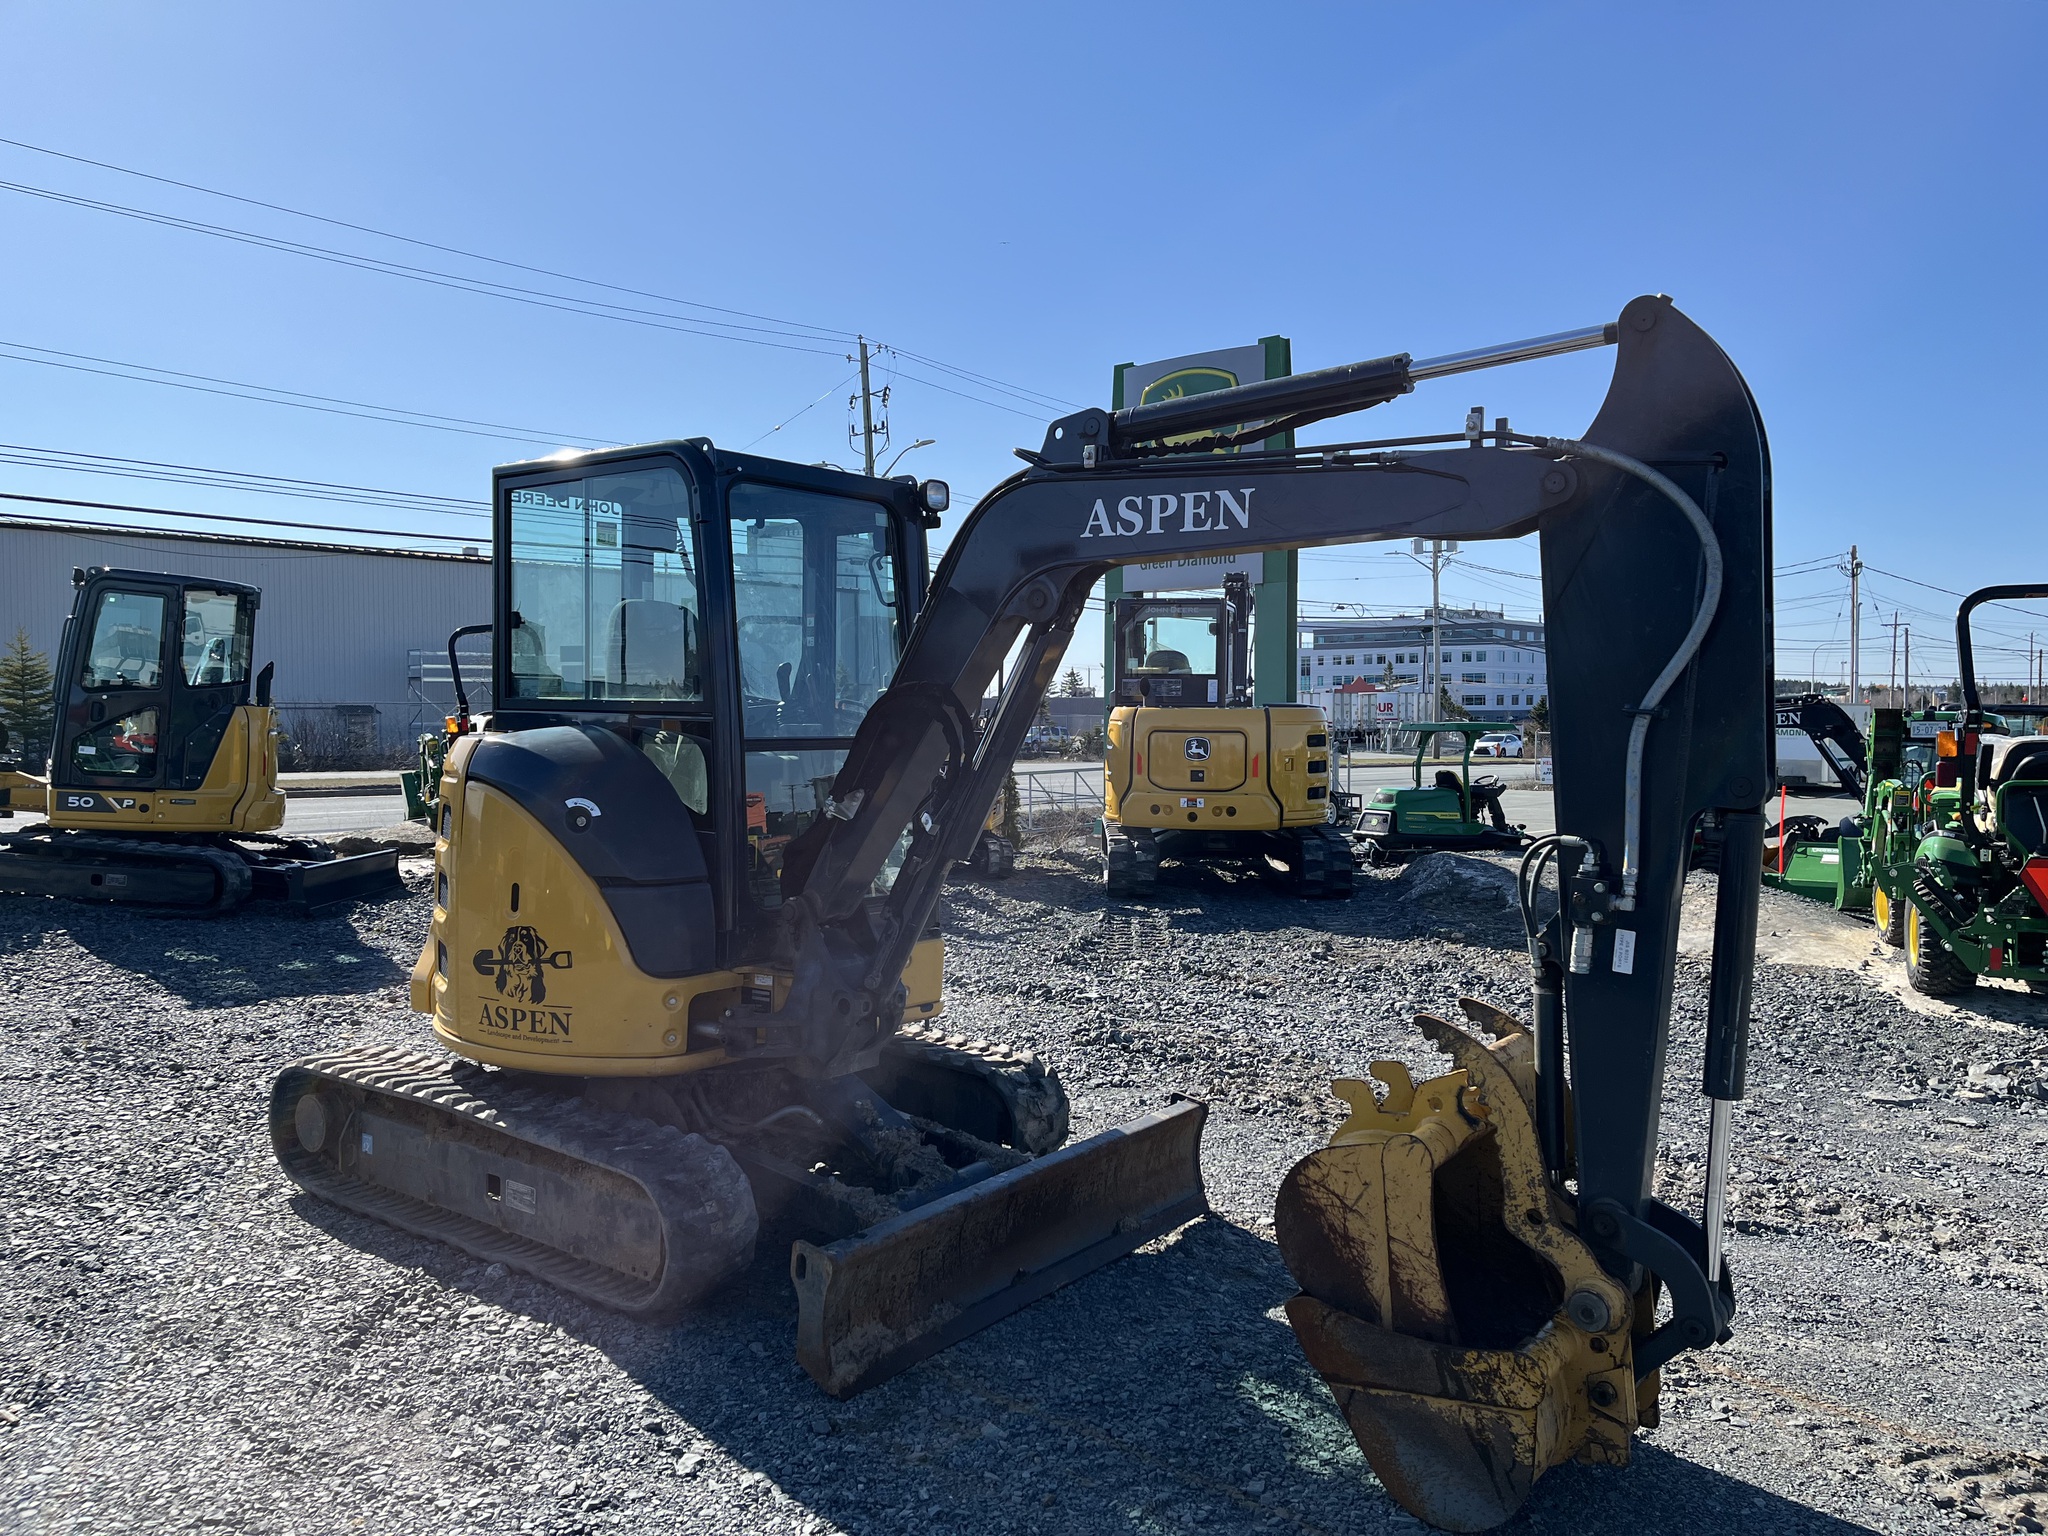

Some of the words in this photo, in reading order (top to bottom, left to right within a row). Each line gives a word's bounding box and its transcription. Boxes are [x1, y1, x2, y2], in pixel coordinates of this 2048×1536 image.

[1079, 487, 1256, 538] ASPEN
[1178, 555, 1236, 567] Diamond
[1170, 606, 1200, 614] DEERE
[1376, 702, 1393, 713] UR
[1775, 711, 1802, 726] EN
[67, 796, 95, 808] 50
[122, 799, 134, 808] P
[478, 1003, 573, 1036] ASPEN
[487, 1029, 512, 1039] Landscape
[522, 1034, 560, 1044] Development
